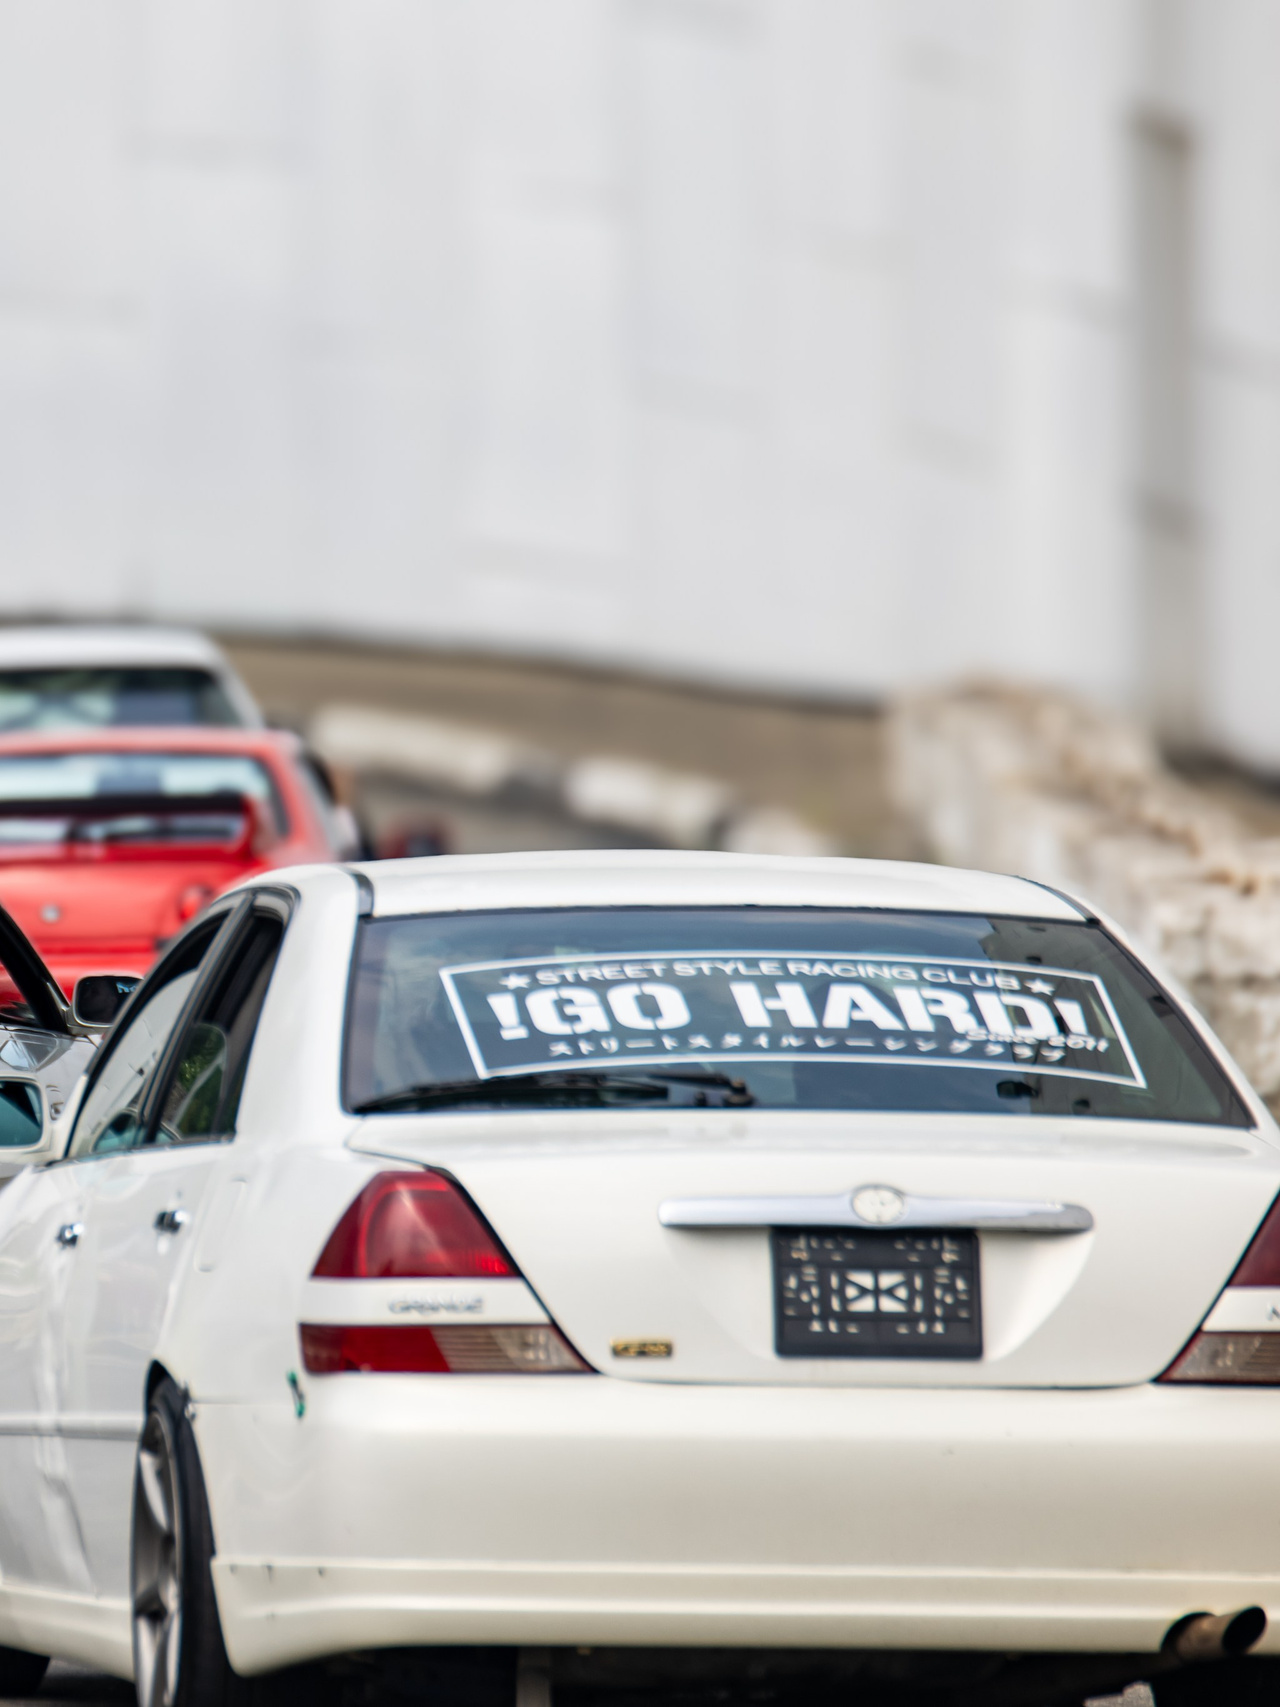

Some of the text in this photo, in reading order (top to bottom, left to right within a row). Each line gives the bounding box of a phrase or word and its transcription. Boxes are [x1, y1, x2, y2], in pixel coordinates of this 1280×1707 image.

[535, 959, 1021, 991] STREET STYLE RACING CLUB
[486, 981, 1090, 1041] !GO HARD!
